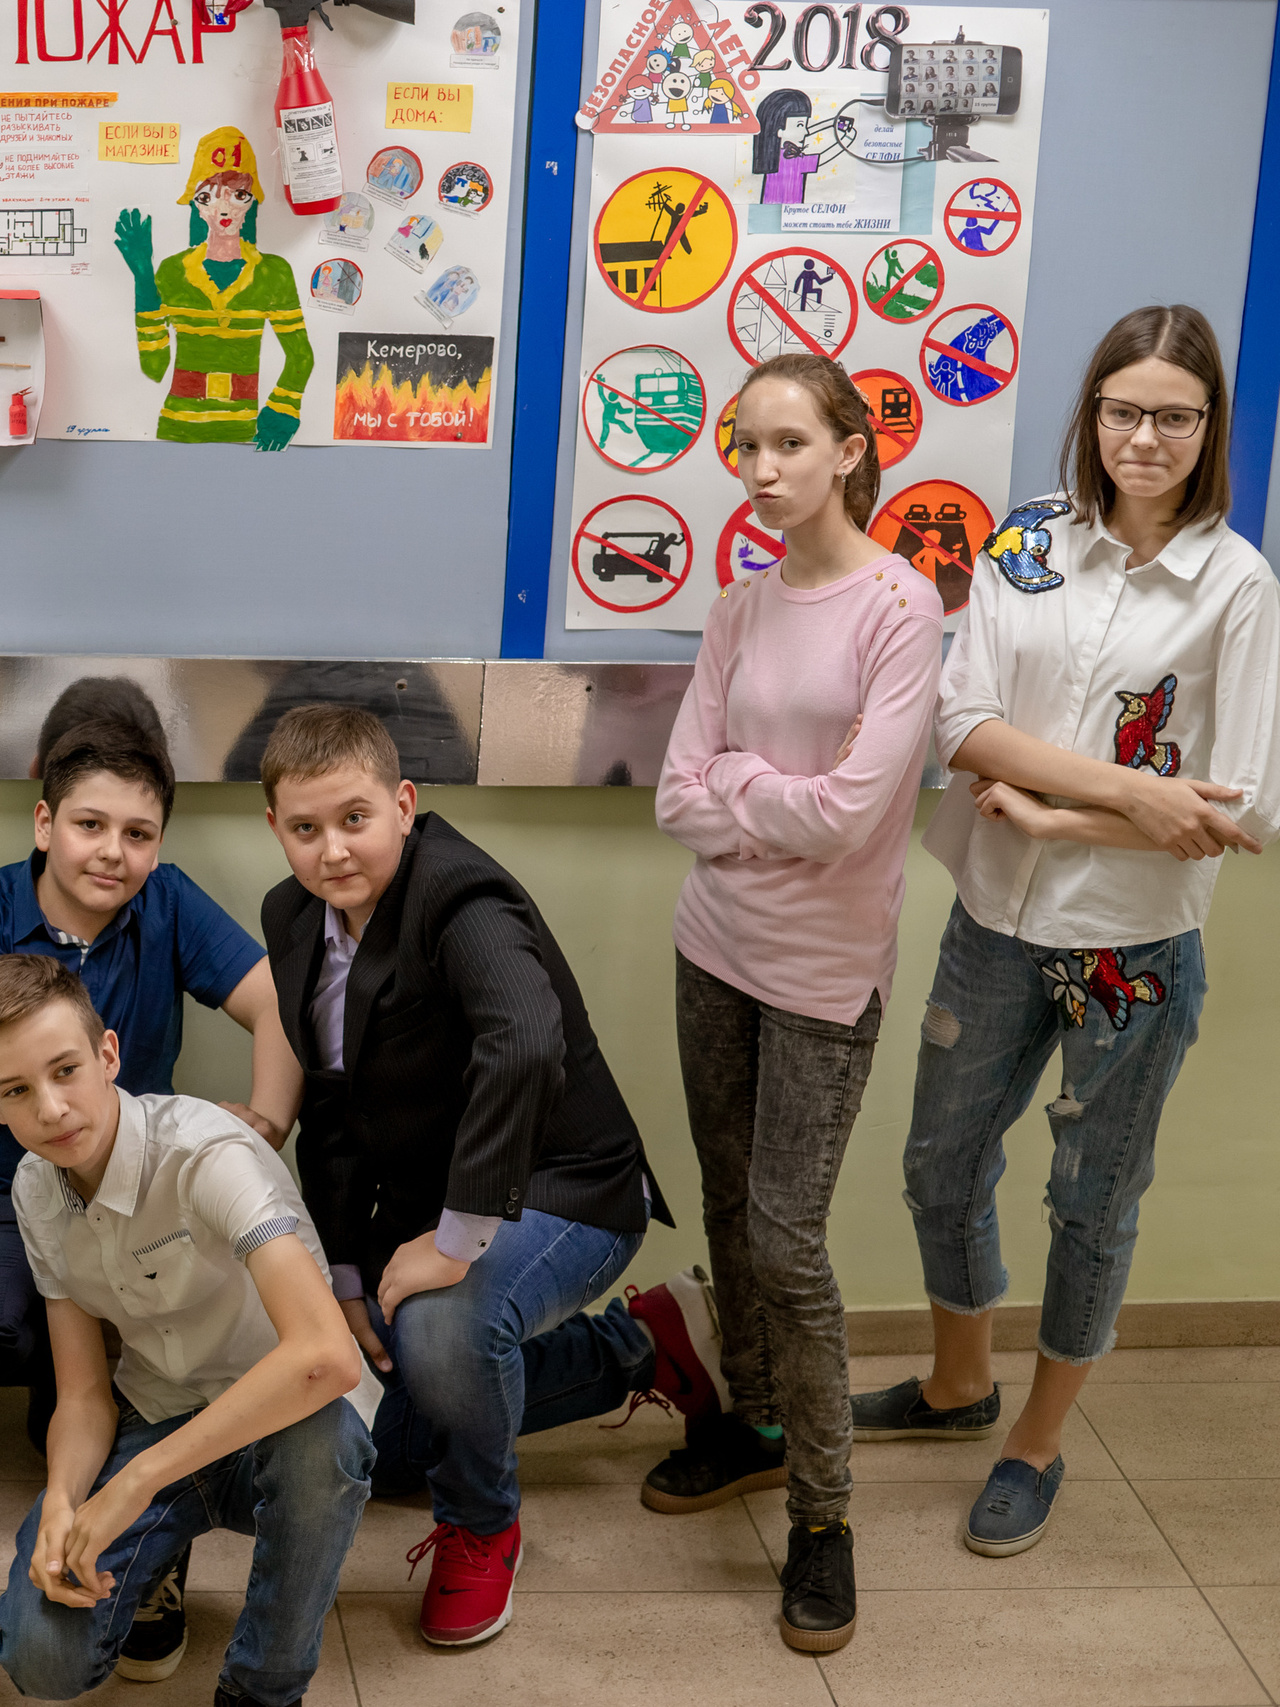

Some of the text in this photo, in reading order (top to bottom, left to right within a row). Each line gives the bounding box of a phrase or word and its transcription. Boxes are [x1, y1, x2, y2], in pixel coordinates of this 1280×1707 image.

[744, 1, 910, 73] 2018
[580, 0, 761, 119] БЕЗОПАСНОЕ ЛЕТО
[393, 87, 461, 102] ЕСЛИ ВЫ
[35, 97, 58, 108] ПРИ
[61, 97, 110, 108] ПОЖАРЕ
[1, 111, 72, 122] НЕ ПЫТАЙТЕСЬ
[391, 108, 443, 125] ДОМА:
[105, 125, 177, 140] ЕСЛИ ВЫ В
[874, 125, 894, 133] делай
[0, 132, 27, 143] ДРУЗЕЙ
[864, 140, 903, 148] безопасные
[105, 144, 176, 158] МАГАЗИНЕ:
[211, 141, 242, 168] 01
[17, 153, 79, 163] ПОДНИМАЙТЕСЬ
[44, 162, 75, 170] ВЫСОКИЕ
[783, 204, 846, 214] Крутое СЕЛФИ
[783, 219, 891, 229] может стоить тебе ЖИЗНИ
[367, 339, 462, 365] Кемерово,
